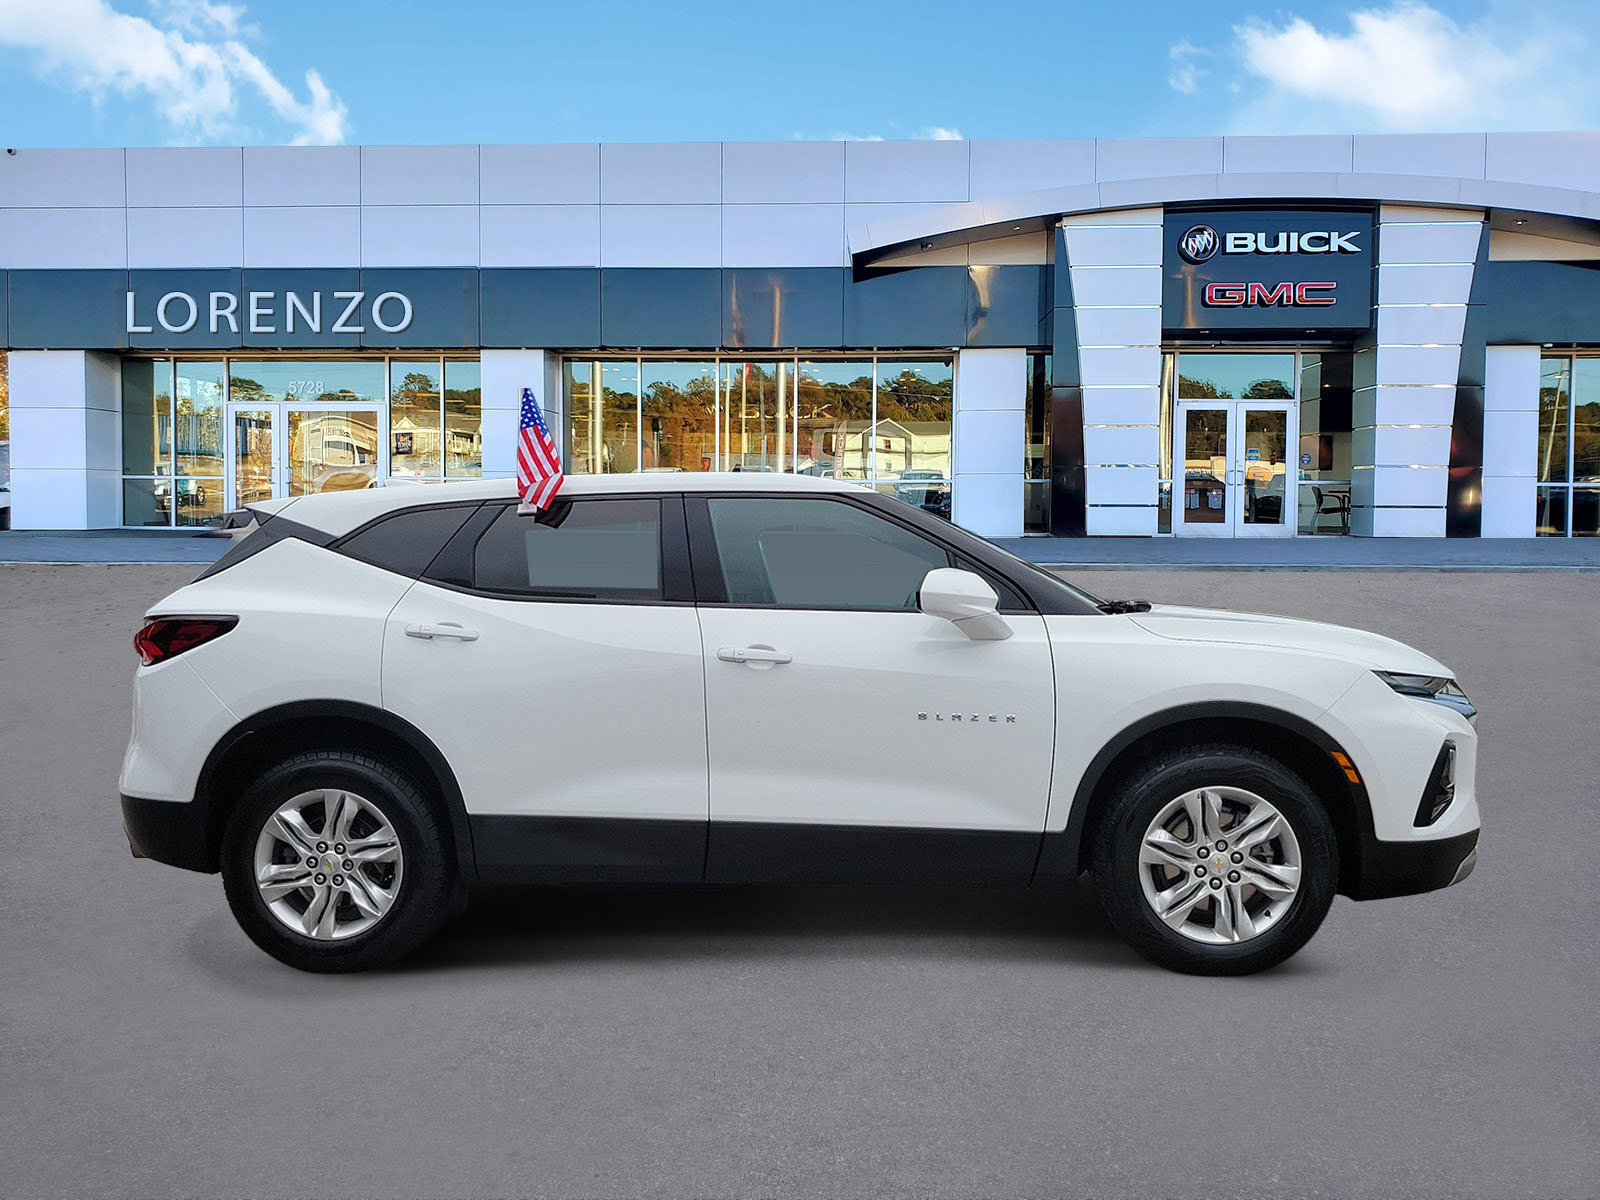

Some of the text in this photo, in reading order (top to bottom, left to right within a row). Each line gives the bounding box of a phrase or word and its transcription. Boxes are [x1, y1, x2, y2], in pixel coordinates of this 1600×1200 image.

[1225, 231, 1362, 253] BUICK
[1206, 282, 1337, 305] GMC
[126, 291, 413, 333] LORENZO
[287, 380, 325, 395] 5728
[918, 711, 1016, 723] BLAZER
